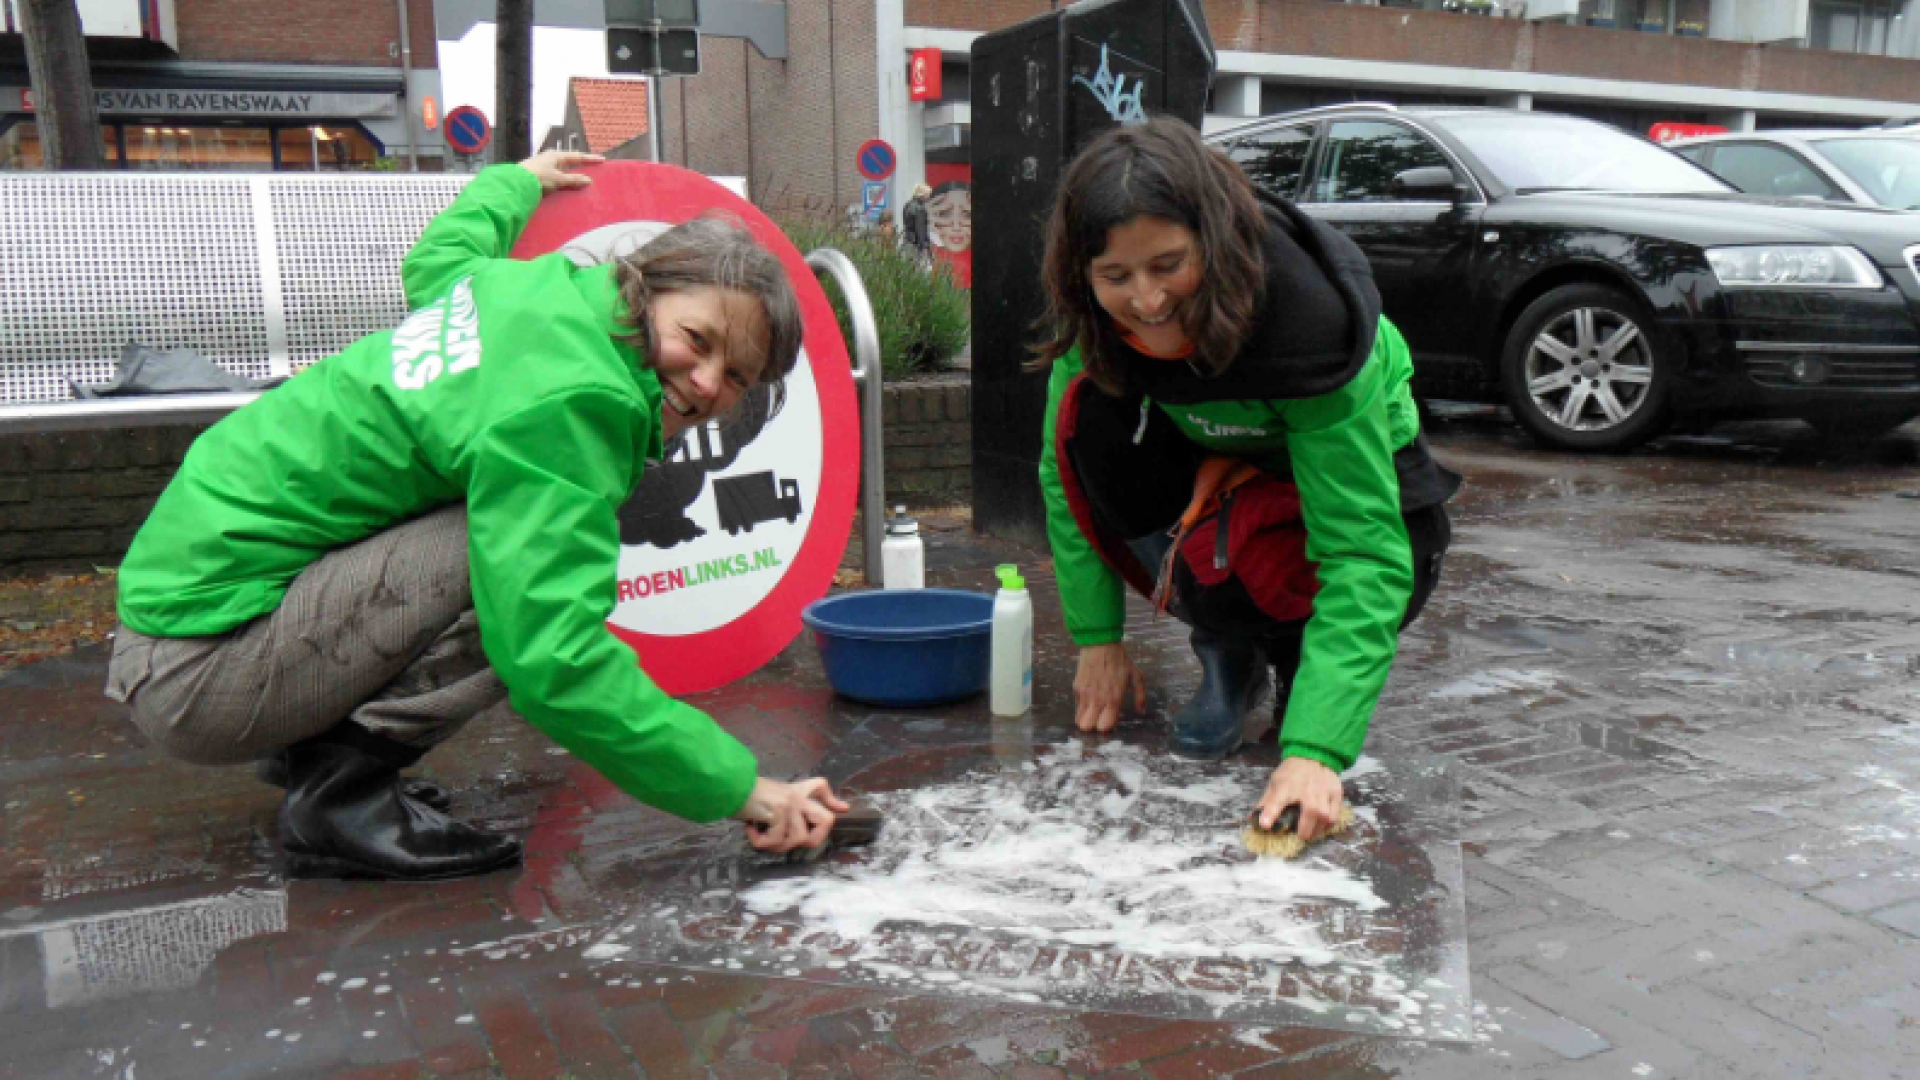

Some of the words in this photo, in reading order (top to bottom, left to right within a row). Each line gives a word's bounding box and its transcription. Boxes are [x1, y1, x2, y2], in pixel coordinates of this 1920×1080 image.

[116, 92, 162, 109] VAN
[167, 92, 313, 112] RAVENSWAAY
[391, 297, 444, 390] INKS
[617, 546, 783, 603] ROENLINKS.NL
